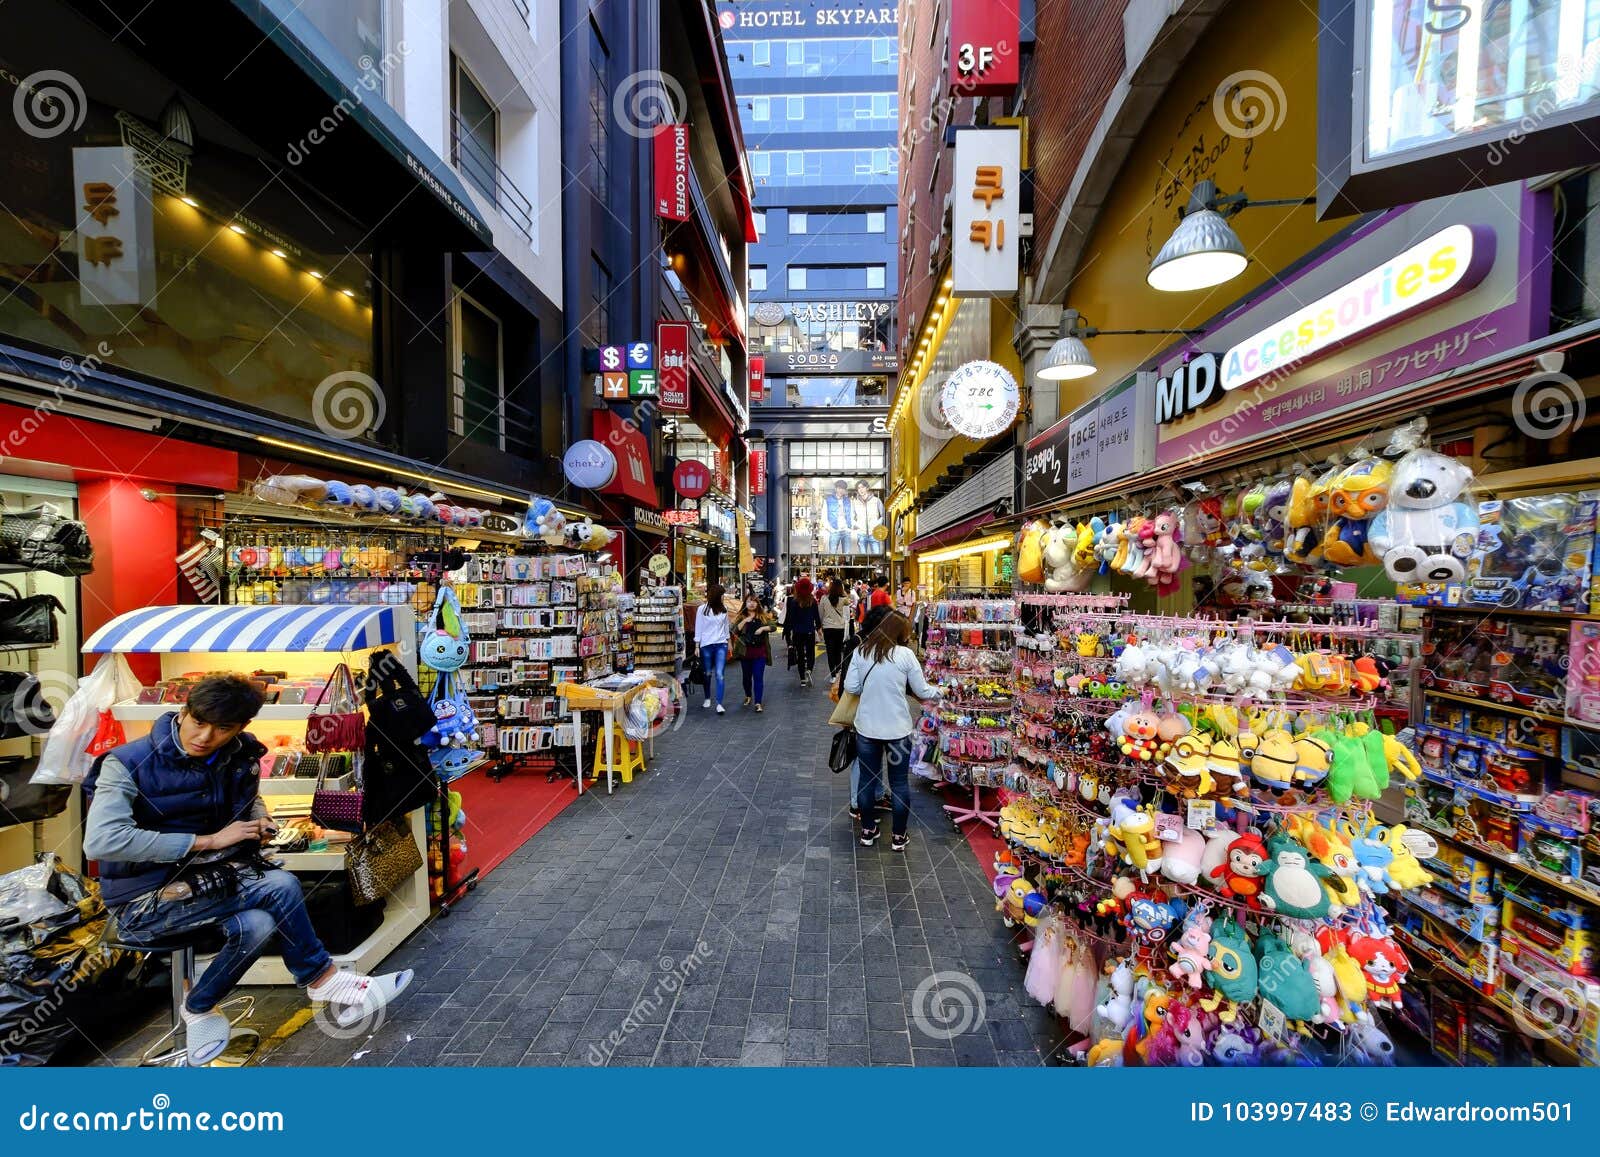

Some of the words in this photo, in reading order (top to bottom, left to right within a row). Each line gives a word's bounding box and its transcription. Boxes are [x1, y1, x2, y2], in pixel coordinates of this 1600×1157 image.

[740, 11, 806, 27] HOTEL
[675, 127, 685, 172] HOLLYS
[676, 174, 686, 217] COFFEE
[969, 165, 1005, 251] 쿠키
[452, 202, 480, 232] COFFEE
[801, 303, 878, 322] ASHLEY
[1155, 352, 1217, 425] MD
[1226, 245, 1458, 383] Accessories
[603, 346, 620, 369] $
[629, 342, 649, 364] €
[486, 516, 510, 531] etc.
[634, 506, 654, 525] HOLLYS
